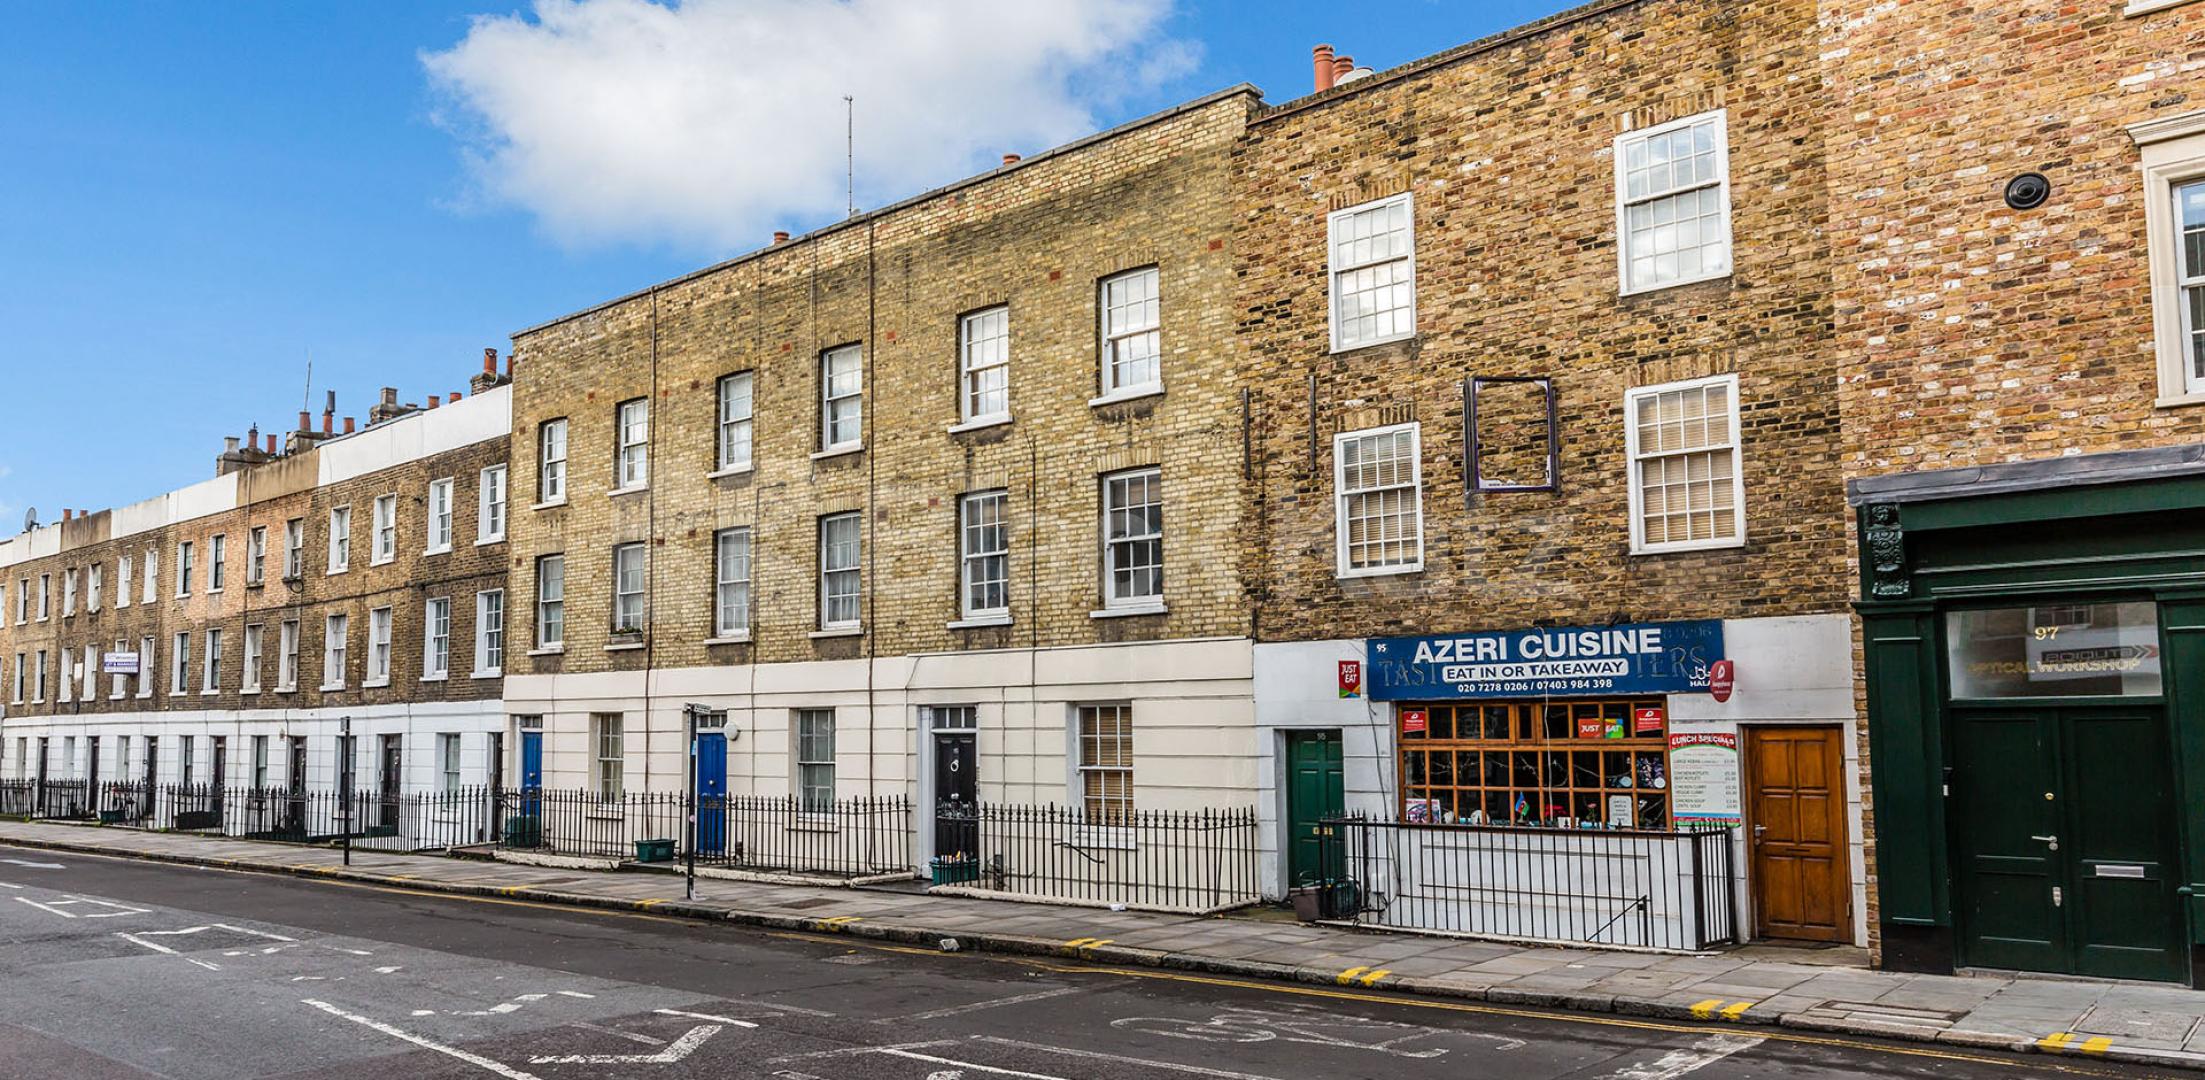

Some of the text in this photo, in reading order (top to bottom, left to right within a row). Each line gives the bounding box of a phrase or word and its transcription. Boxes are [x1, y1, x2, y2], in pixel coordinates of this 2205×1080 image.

[2034, 625, 2059, 640] 97
[1376, 643, 1387, 653] 95
[1413, 637, 1508, 664] AZERI
[1519, 628, 1663, 659] CUISINE
[1341, 664, 1357, 675] JUST
[1447, 661, 1624, 679] EAT IN OR TAKEAWAY
[1345, 674, 1357, 683] EAT
[1458, 684, 1475, 692] 020
[1478, 683, 1501, 692] 7278
[1504, 682, 1528, 691] 0206
[1536, 680, 1567, 690] 07403
[1571, 680, 1590, 689] 984
[1593, 679, 1613, 688] 398
[1581, 724, 1600, 733] JUST
[1672, 735, 1697, 745] LUNCH
